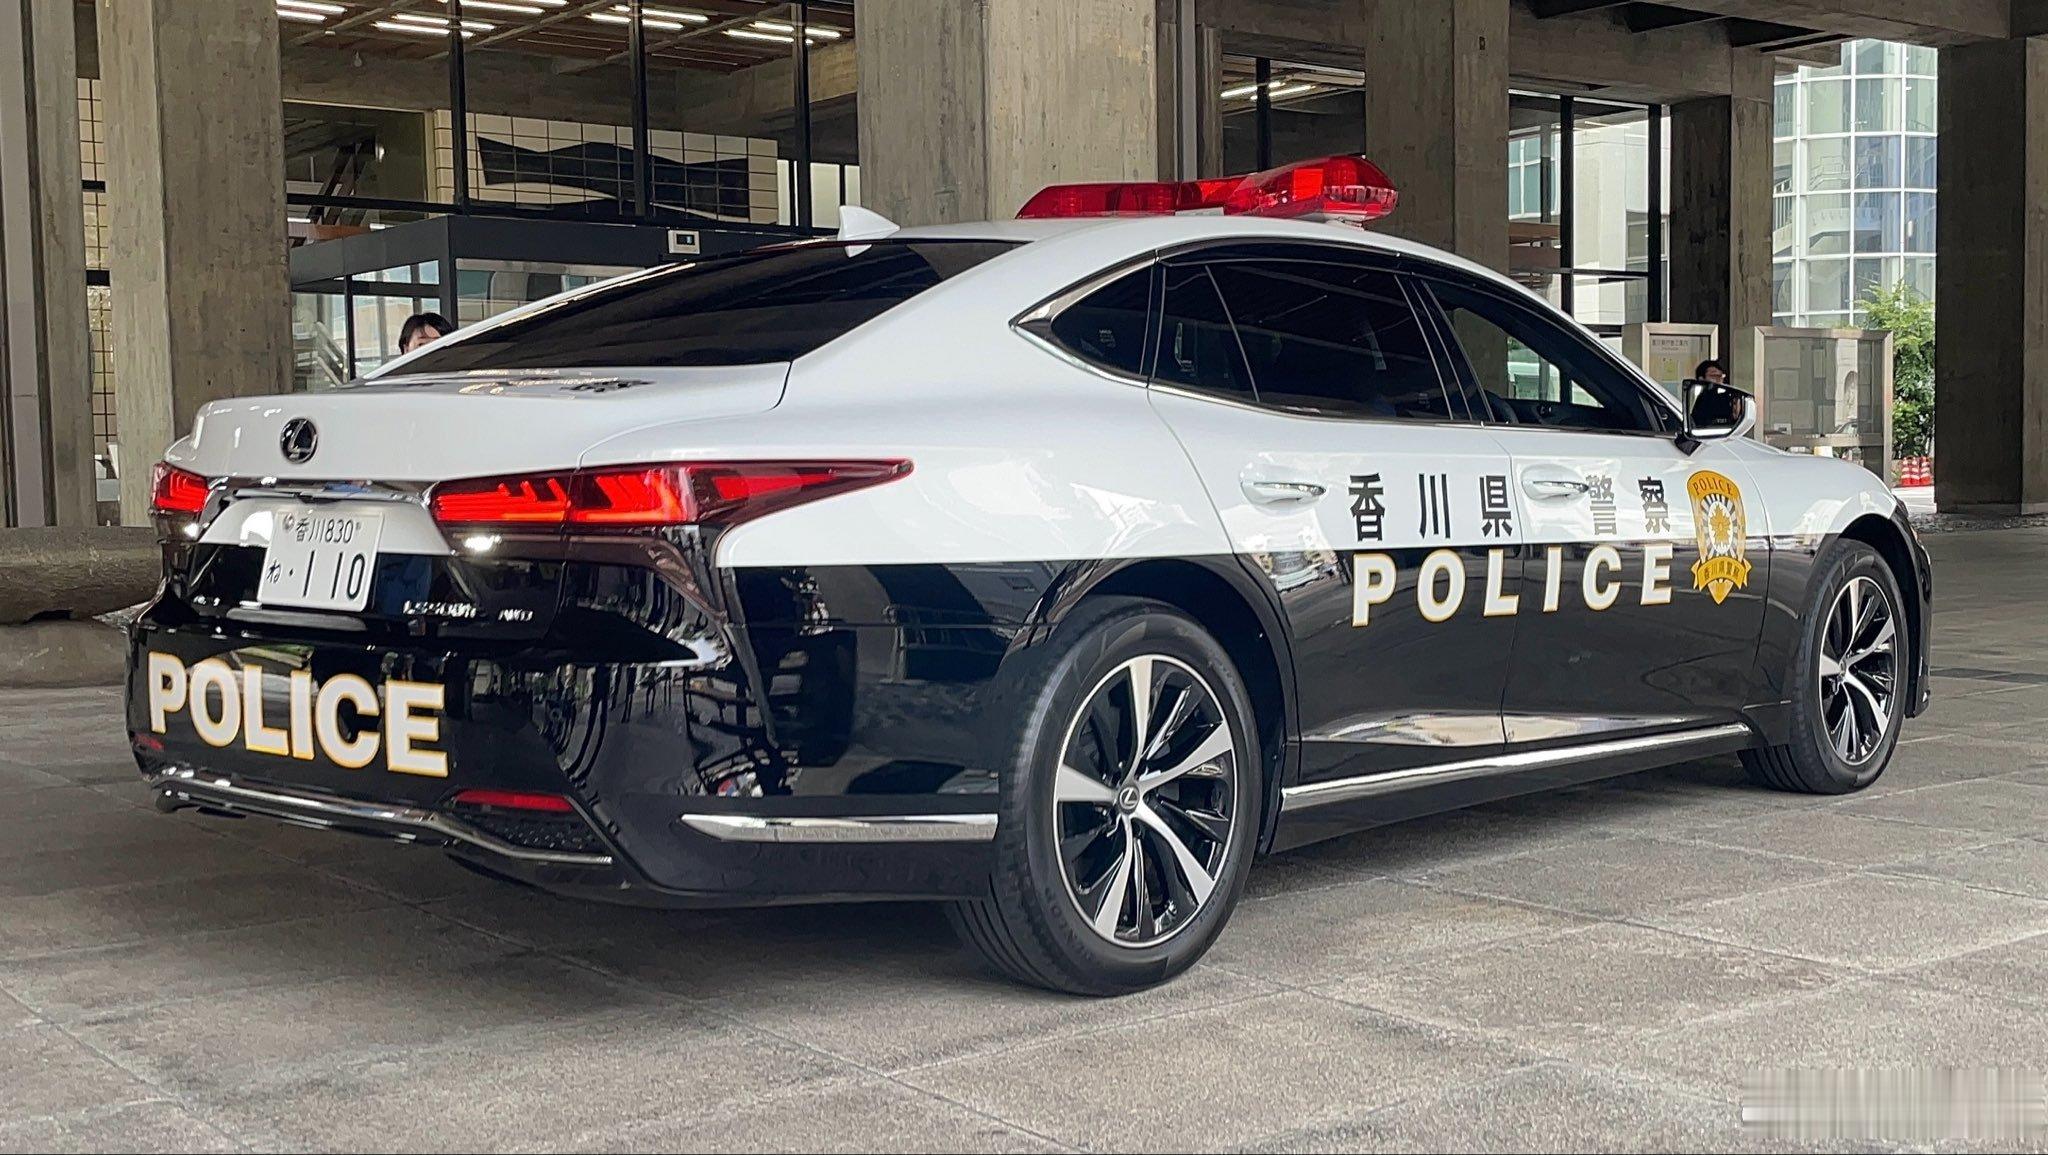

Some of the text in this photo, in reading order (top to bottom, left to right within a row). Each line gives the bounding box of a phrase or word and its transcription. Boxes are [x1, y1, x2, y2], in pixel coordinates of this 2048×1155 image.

[1348, 473, 1671, 542] 香川県警察
[1693, 478, 1733, 496] POLICE
[1351, 543, 1674, 628] POLICE
[148, 651, 449, 778] POLICE
